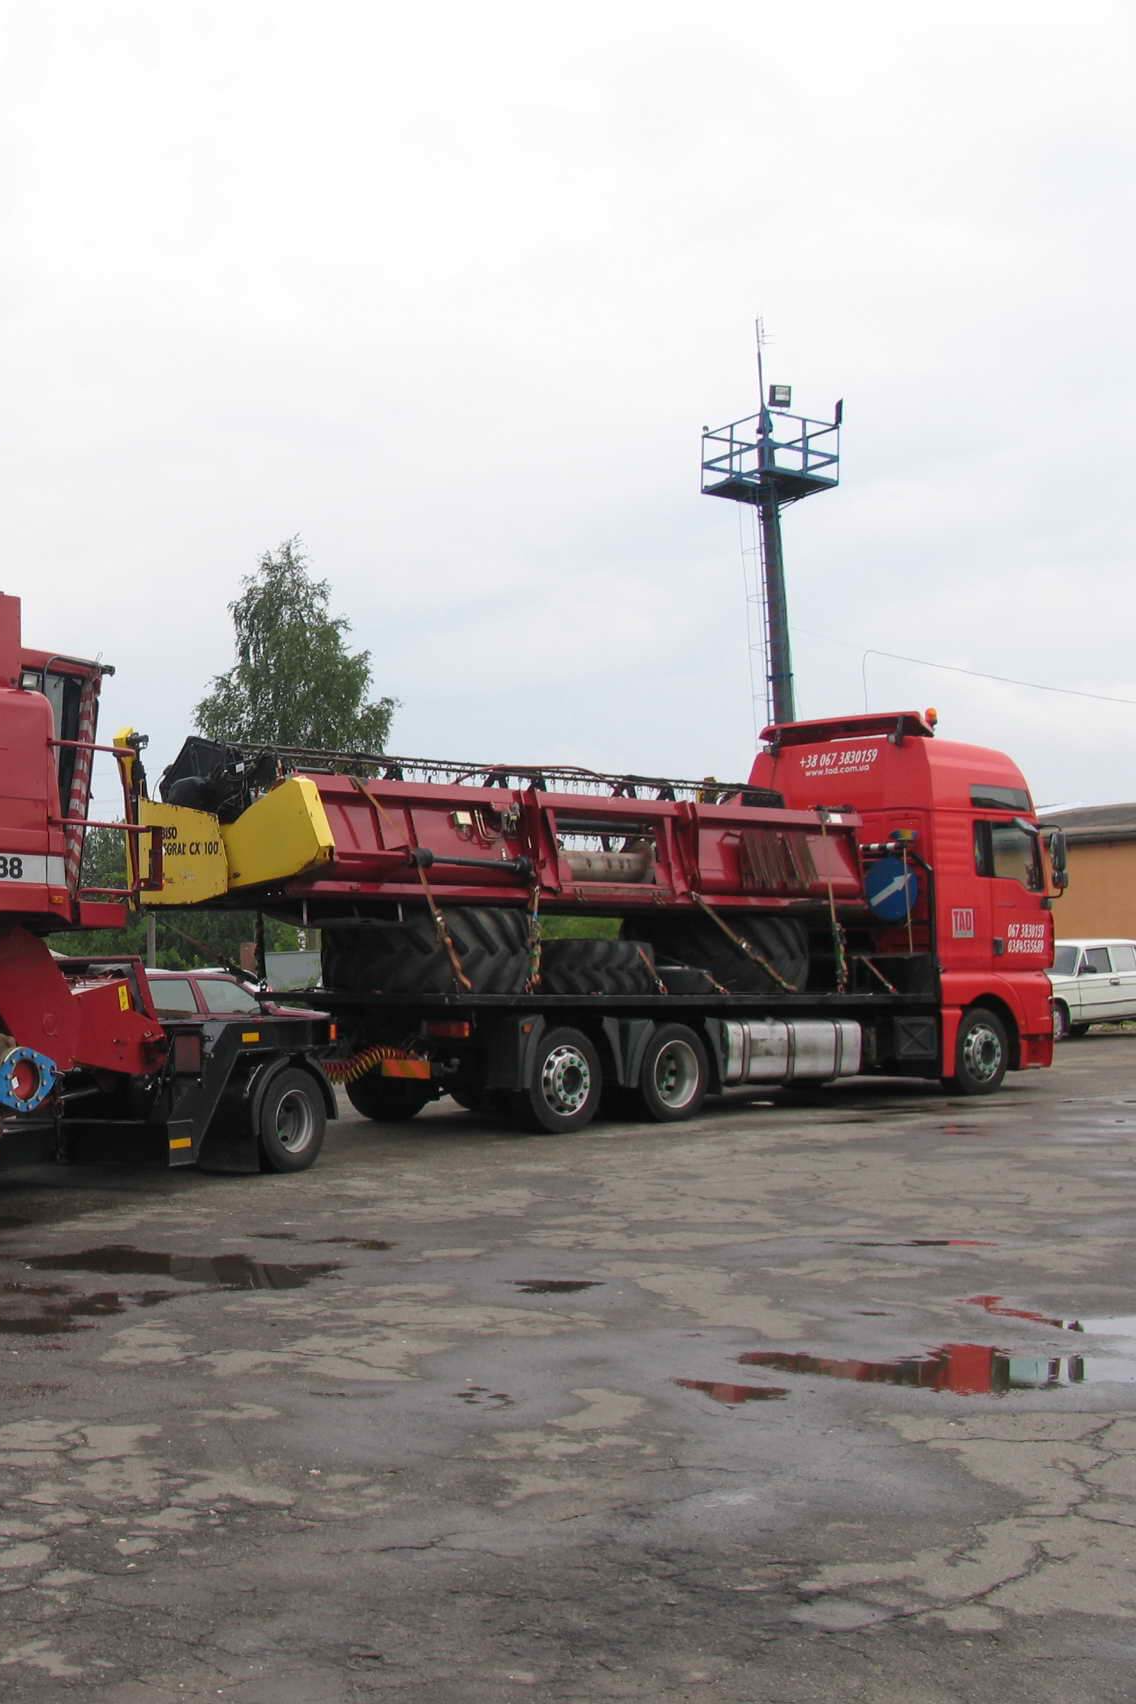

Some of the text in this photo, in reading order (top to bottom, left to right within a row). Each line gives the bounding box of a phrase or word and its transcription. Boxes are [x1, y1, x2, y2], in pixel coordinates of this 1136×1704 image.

[800, 749, 878, 768] +38 067 3830159
[189, 842, 200, 855] CX
[205, 842, 219, 855] 100
